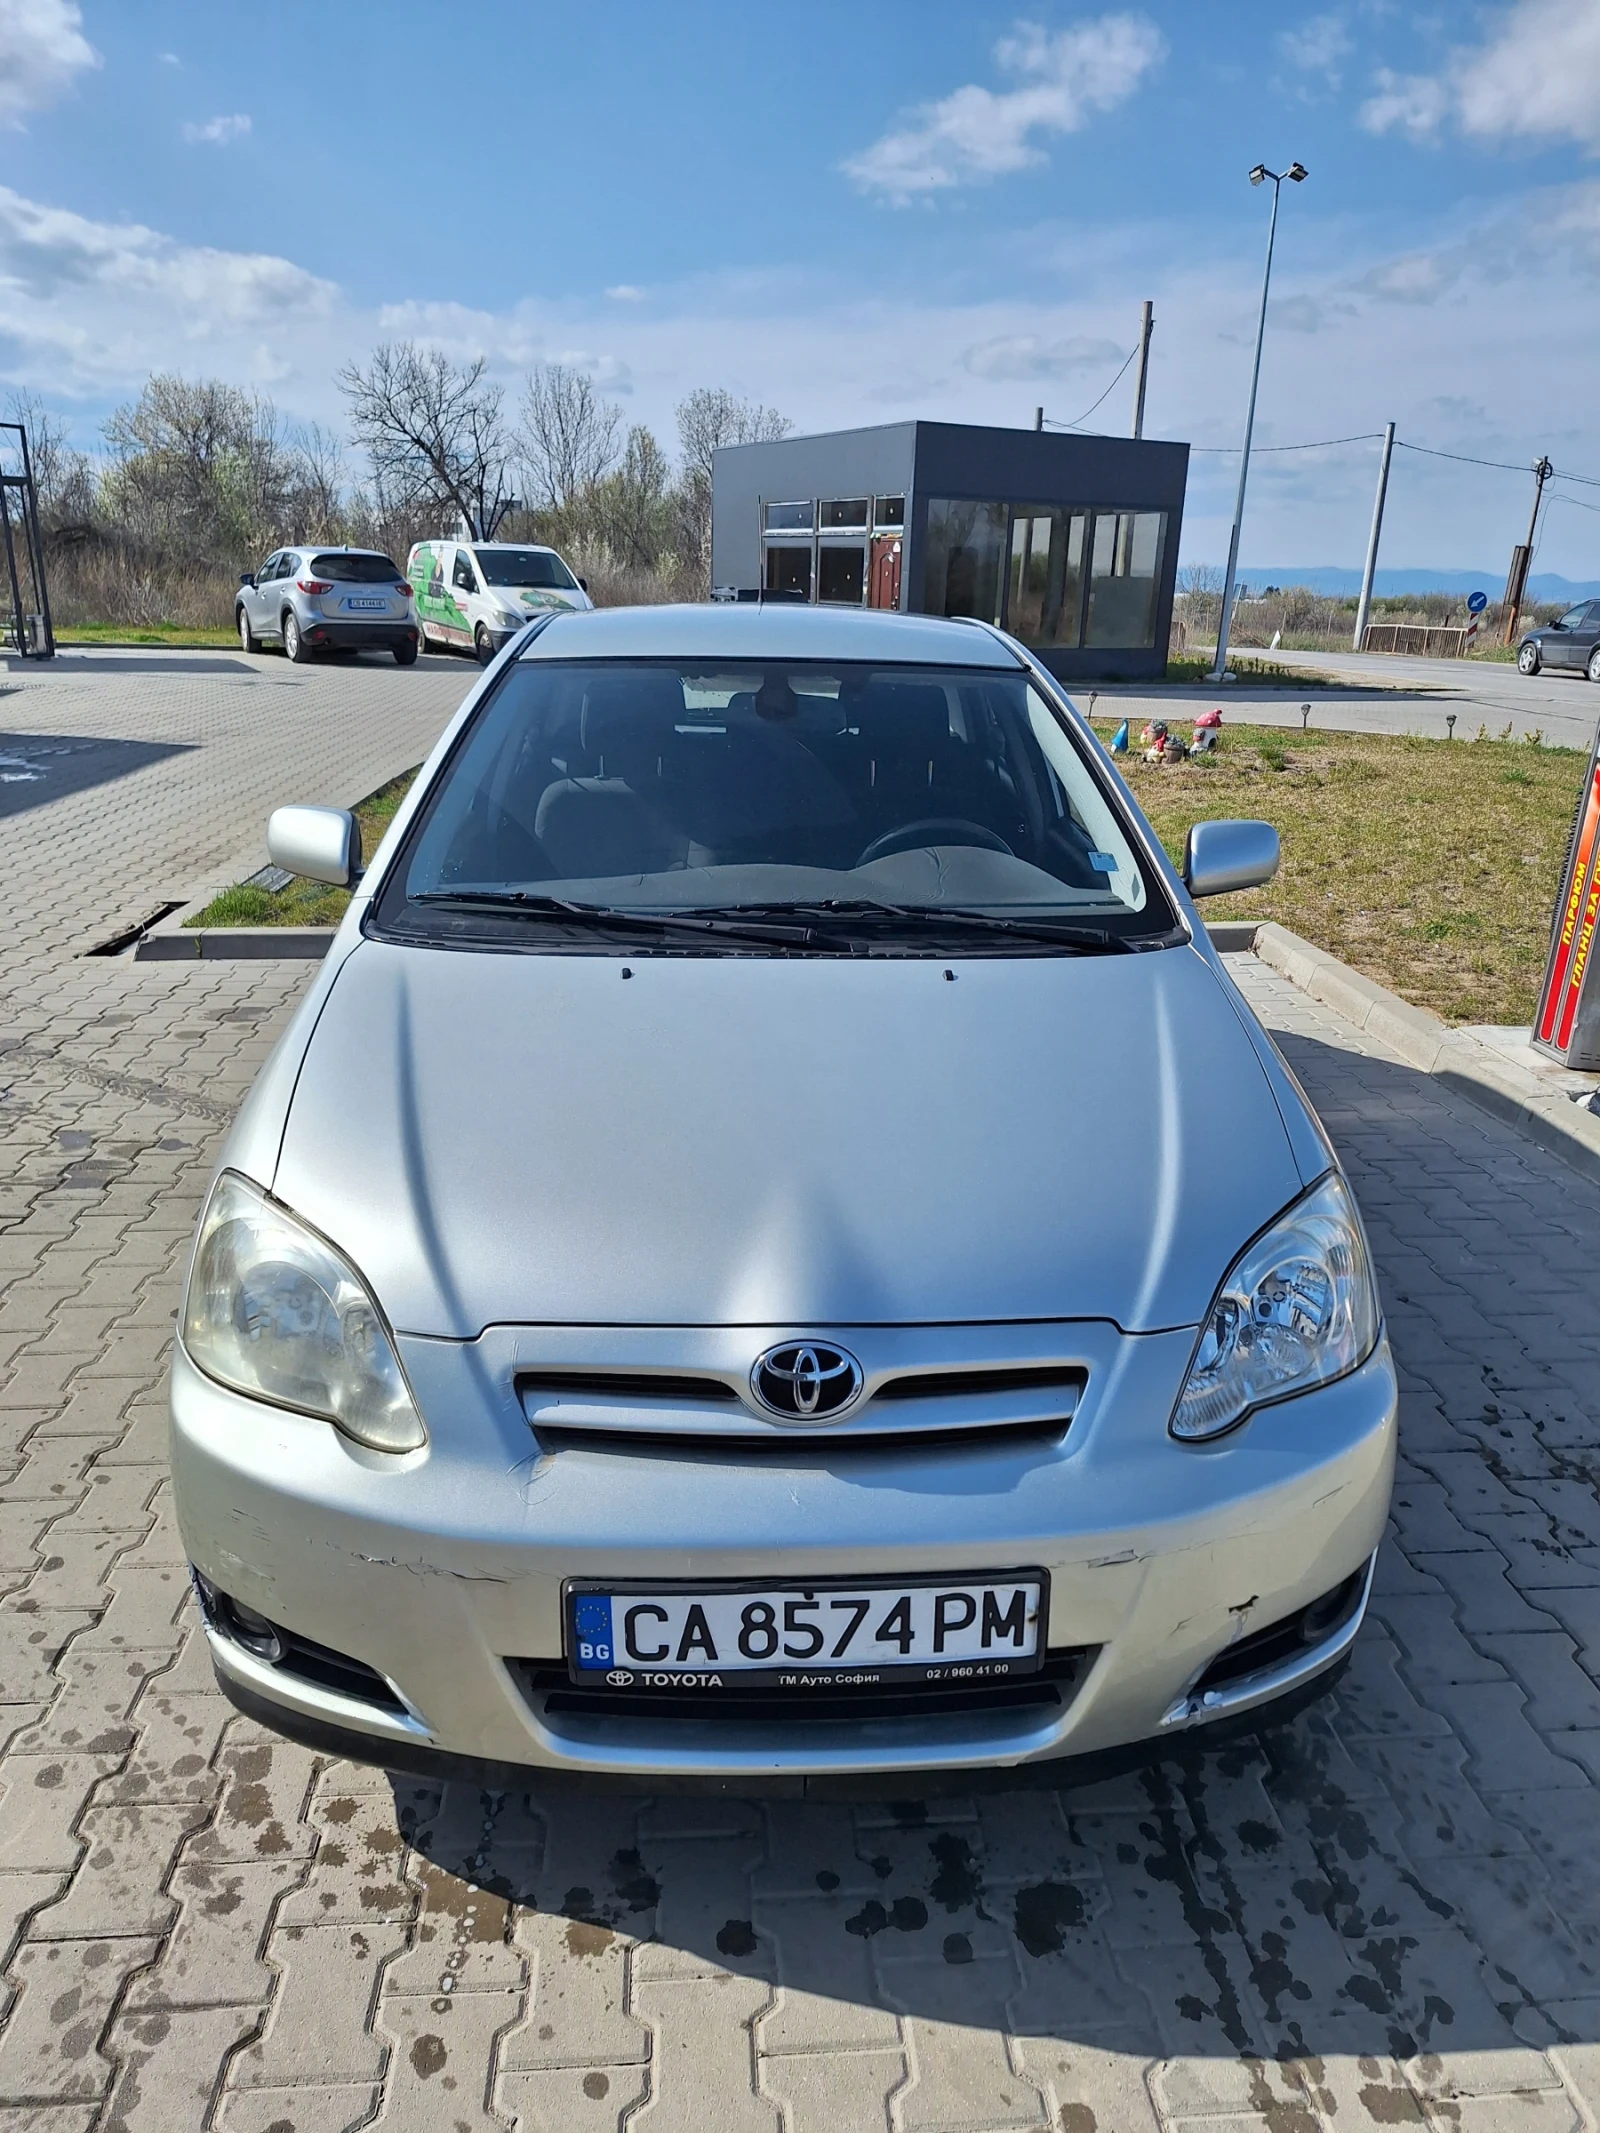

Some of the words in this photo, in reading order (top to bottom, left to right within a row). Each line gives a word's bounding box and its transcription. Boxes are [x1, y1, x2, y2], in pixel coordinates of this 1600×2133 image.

[1562, 862, 1586, 945] ПАРФЮМ
[1571, 922, 1594, 988] ГЛАНЦ
[1587, 893, 1599, 917] ЗА
[624, 1604, 719, 1662] CA
[738, 1596, 915, 1659] 8574
[933, 1590, 1026, 1653] PM
[580, 1643, 610, 1660] BG
[641, 1672, 723, 1687] TOYOTA
[800, 1675, 832, 1686] Ауто
[835, 1673, 880, 1685] София
[926, 1669, 941, 1679] 02
[951, 1667, 973, 1677] 960
[976, 1665, 990, 1675] 41
[994, 1664, 1009, 1674] 00
